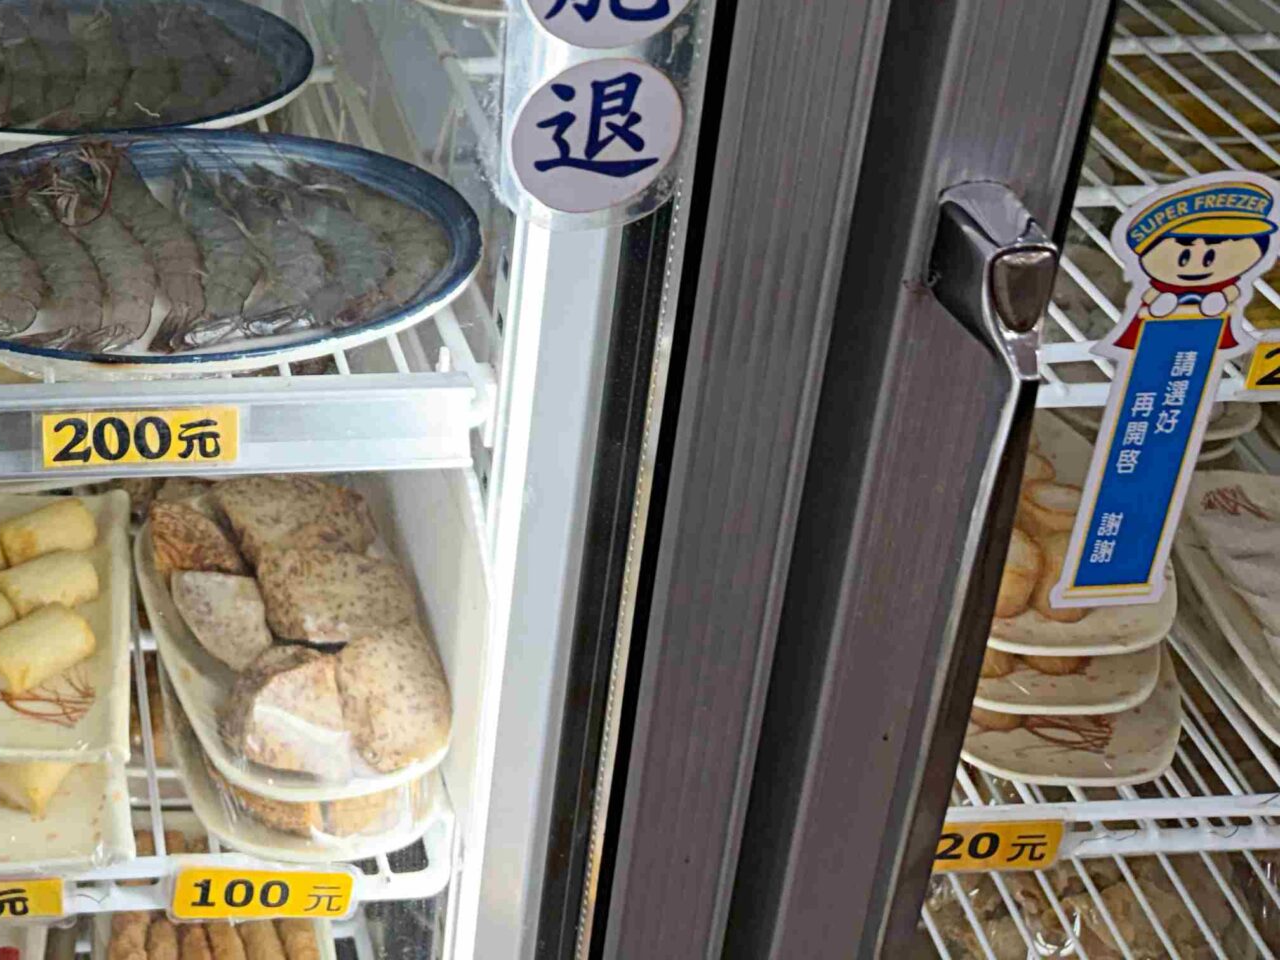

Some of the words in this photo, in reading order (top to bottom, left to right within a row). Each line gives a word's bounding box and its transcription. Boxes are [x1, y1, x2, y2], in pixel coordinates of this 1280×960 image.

[1130, 200, 1189, 243] SUPER
[1194, 193, 1270, 213] FREEZER
[1154, 351, 1198, 434] 請選好
[53, 417, 221, 462] 200元
[1089, 512, 1124, 564] 謝謝
[191, 879, 342, 912] 100元
